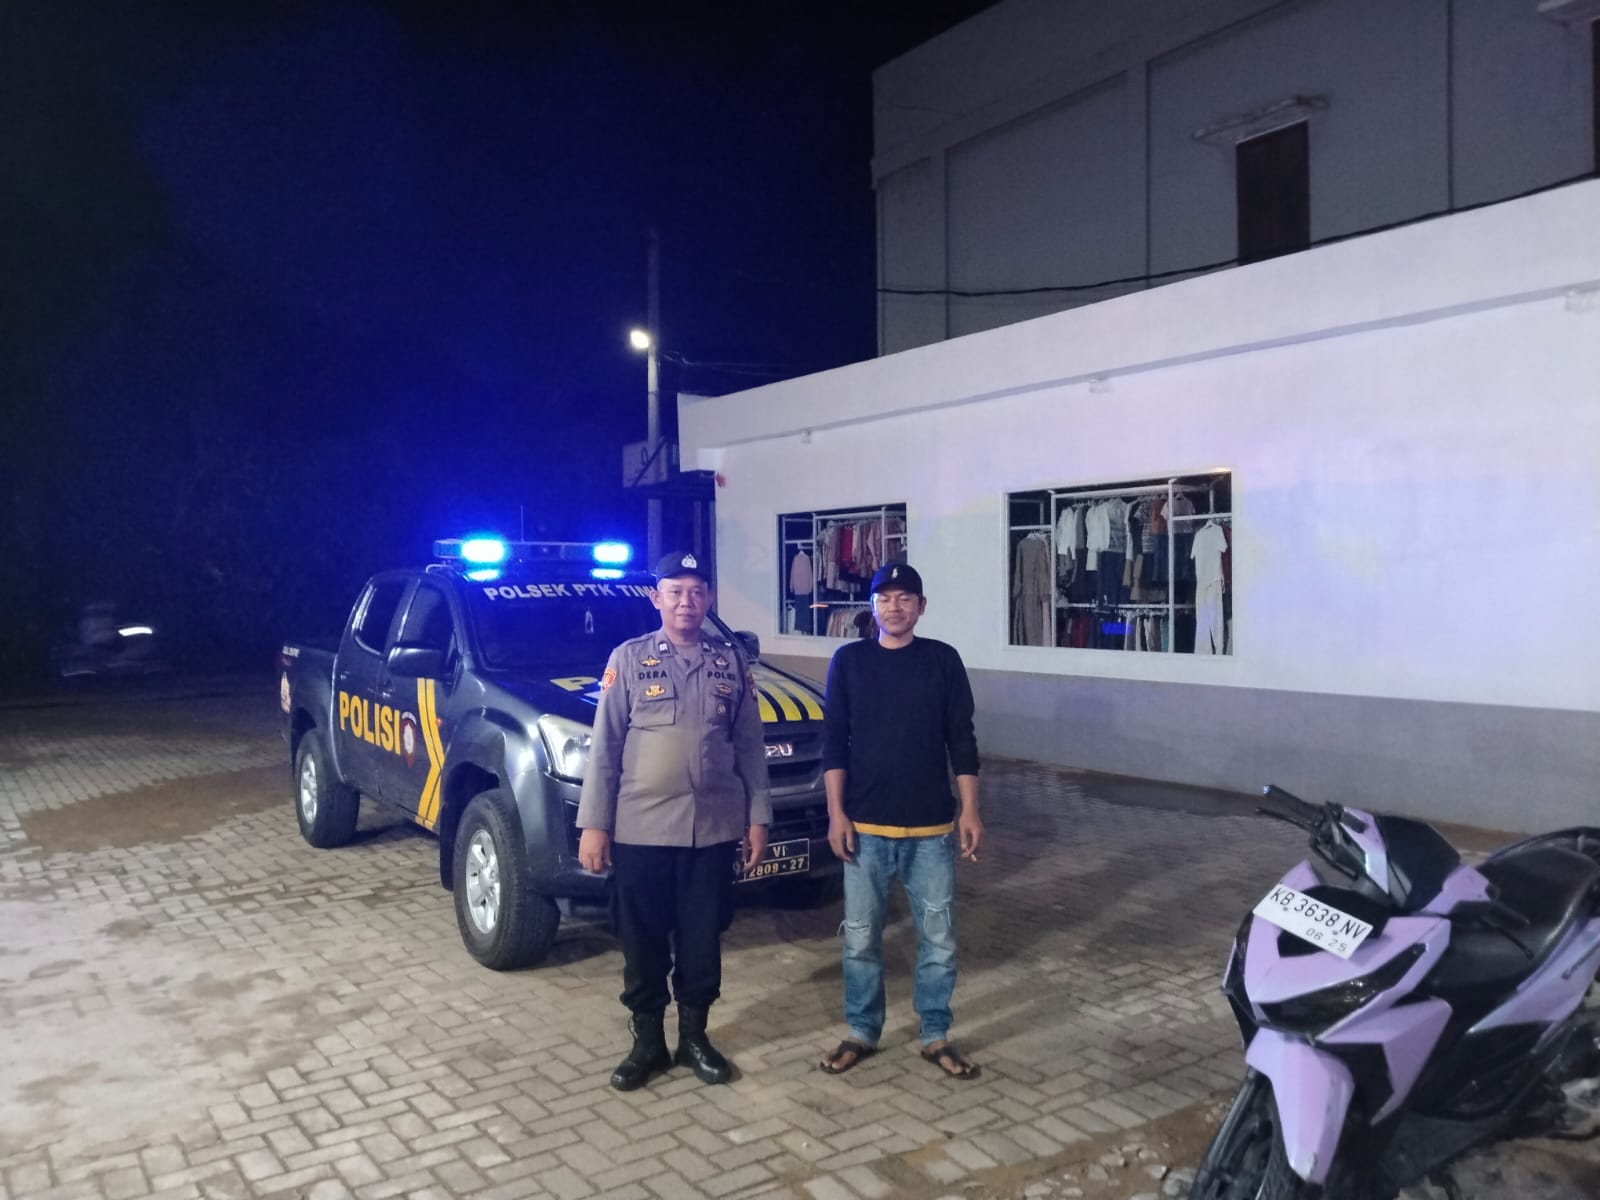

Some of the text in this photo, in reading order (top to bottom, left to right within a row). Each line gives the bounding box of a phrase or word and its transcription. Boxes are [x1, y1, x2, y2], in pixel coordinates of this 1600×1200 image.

[483, 583, 653, 600] POLSEK PTK TIM
[638, 670, 668, 681] DERA
[339, 691, 401, 755] POLISI
[1270, 888, 1368, 940] KB 3638 NV
[1305, 928, 1348, 952] 06 25
